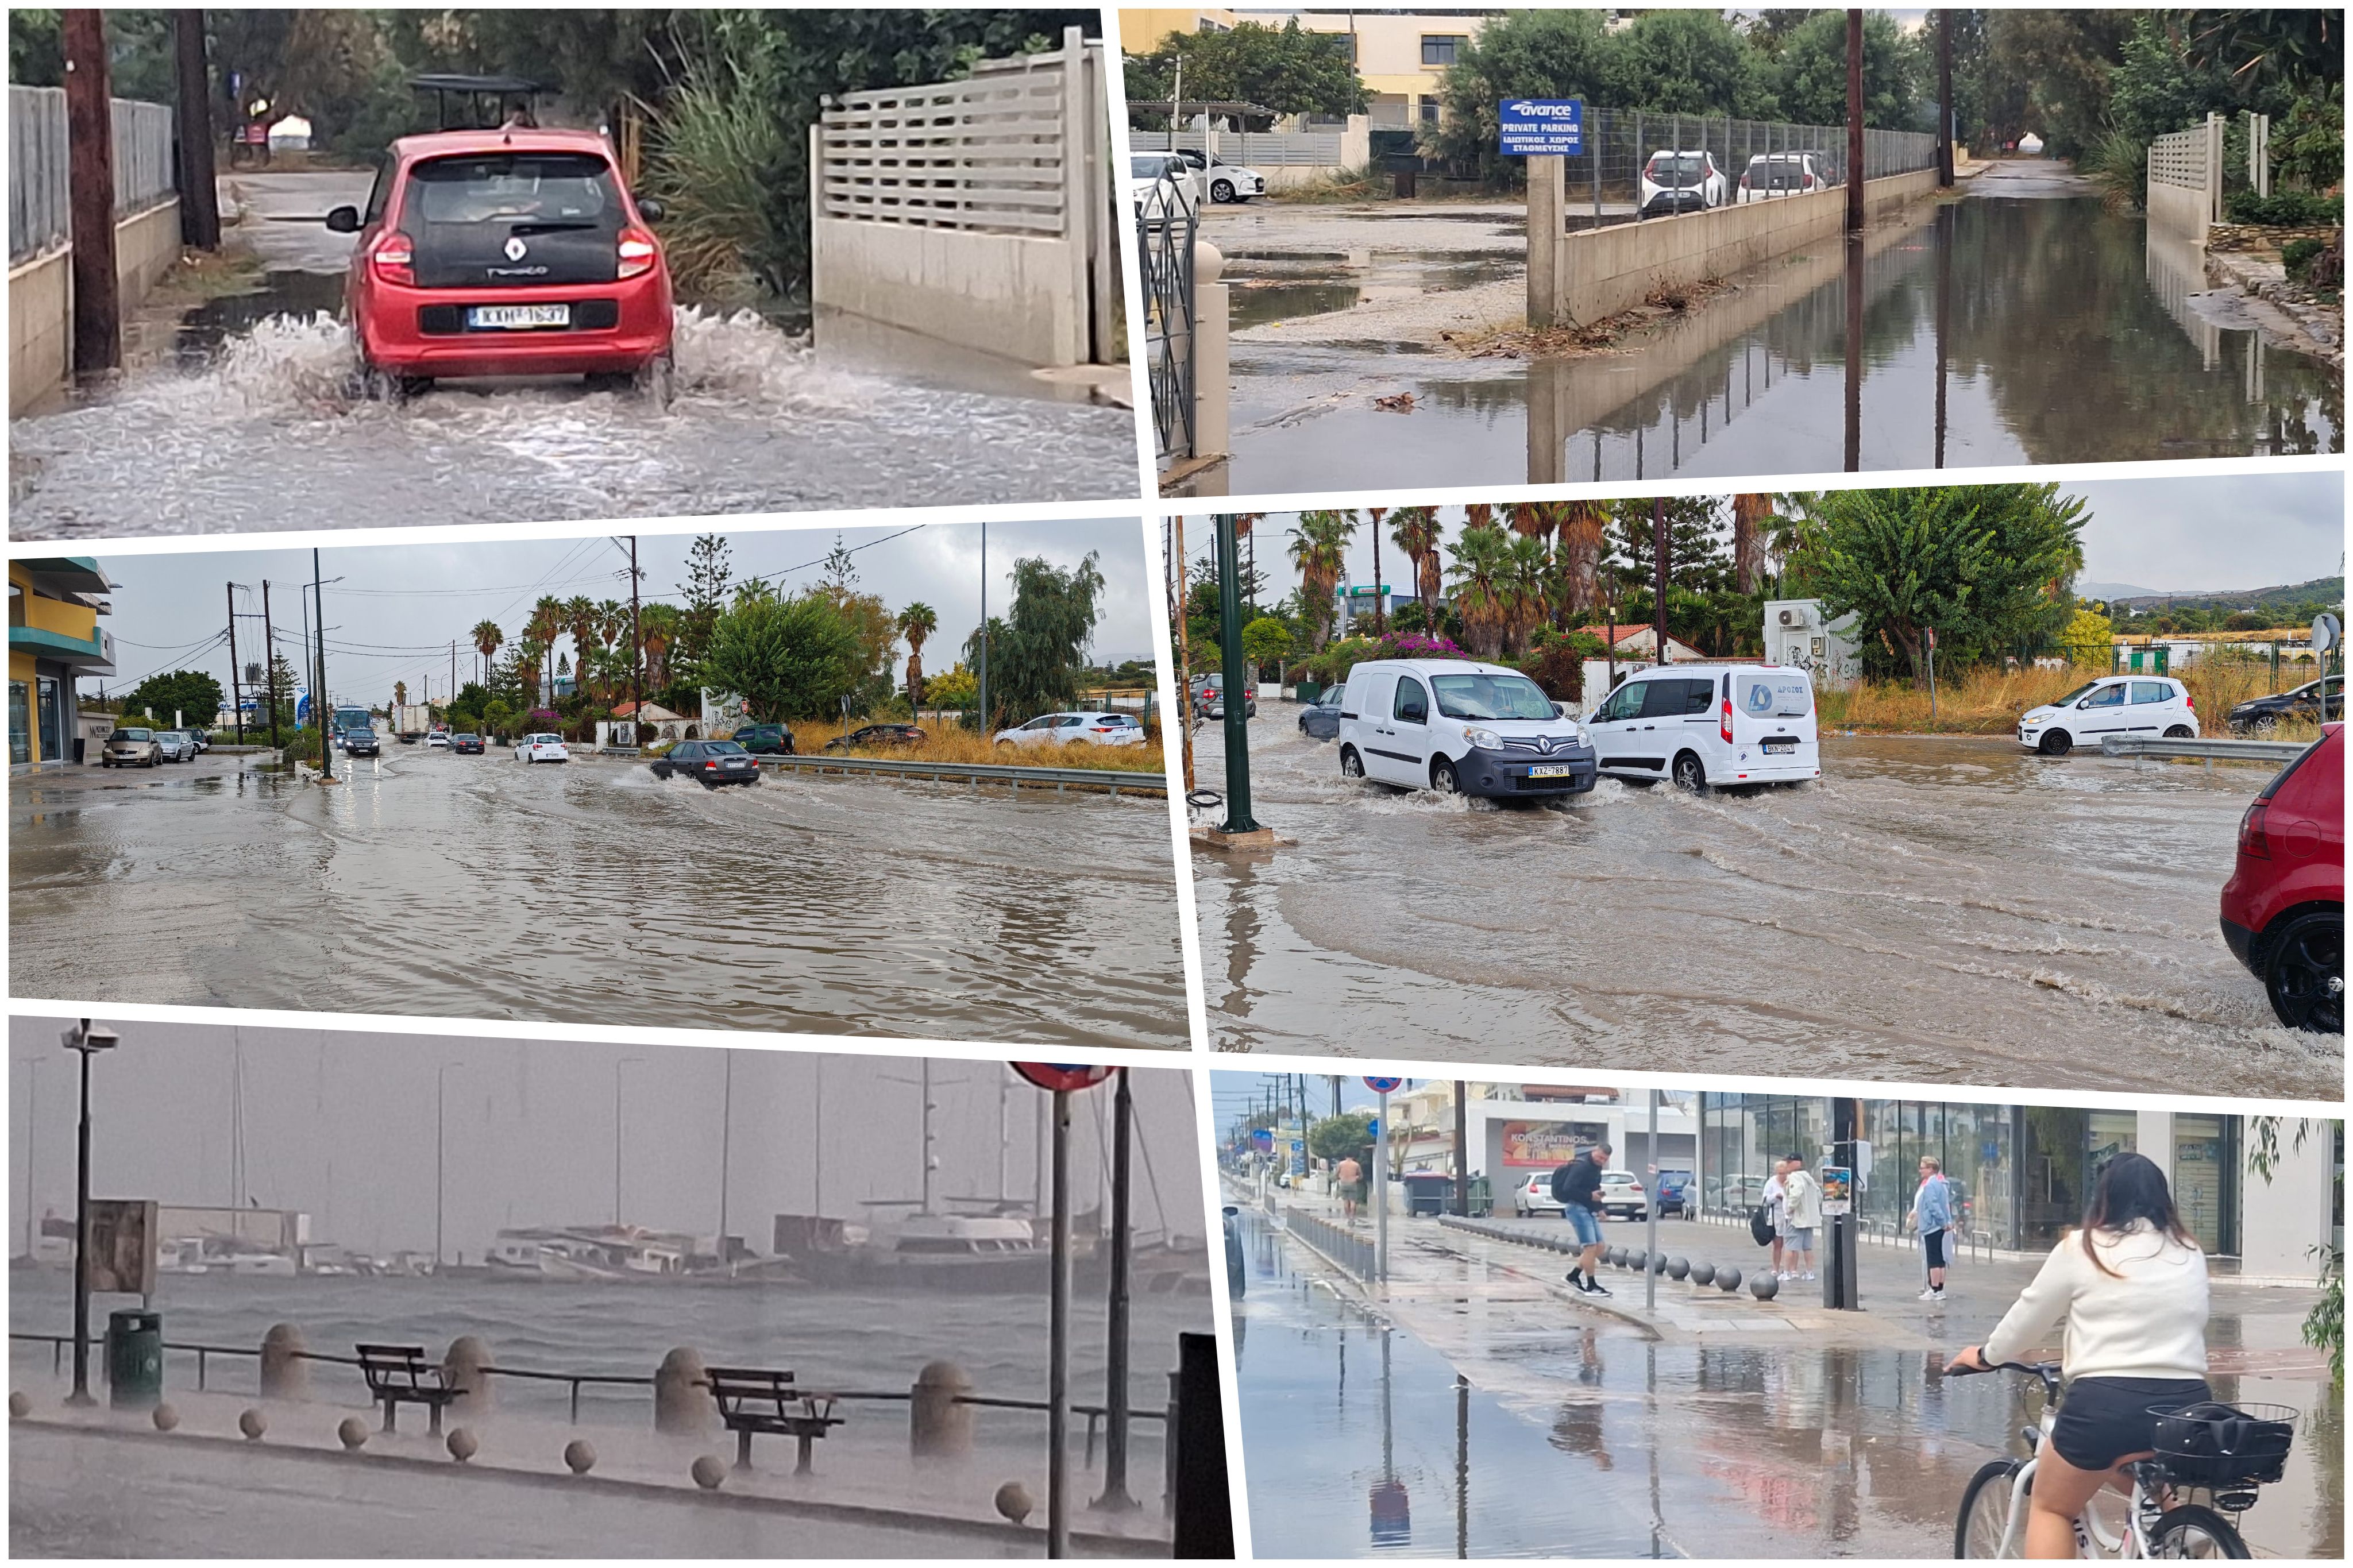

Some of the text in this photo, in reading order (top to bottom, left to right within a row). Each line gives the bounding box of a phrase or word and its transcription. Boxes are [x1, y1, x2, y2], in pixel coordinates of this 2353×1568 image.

[1521, 105, 1571, 115] avance
[1502, 123, 1578, 133] PRIVATE PARKING
[1534, 766, 1568, 775] KXZ-7887
[1511, 1134, 1587, 1144] KONSTANTINOS
